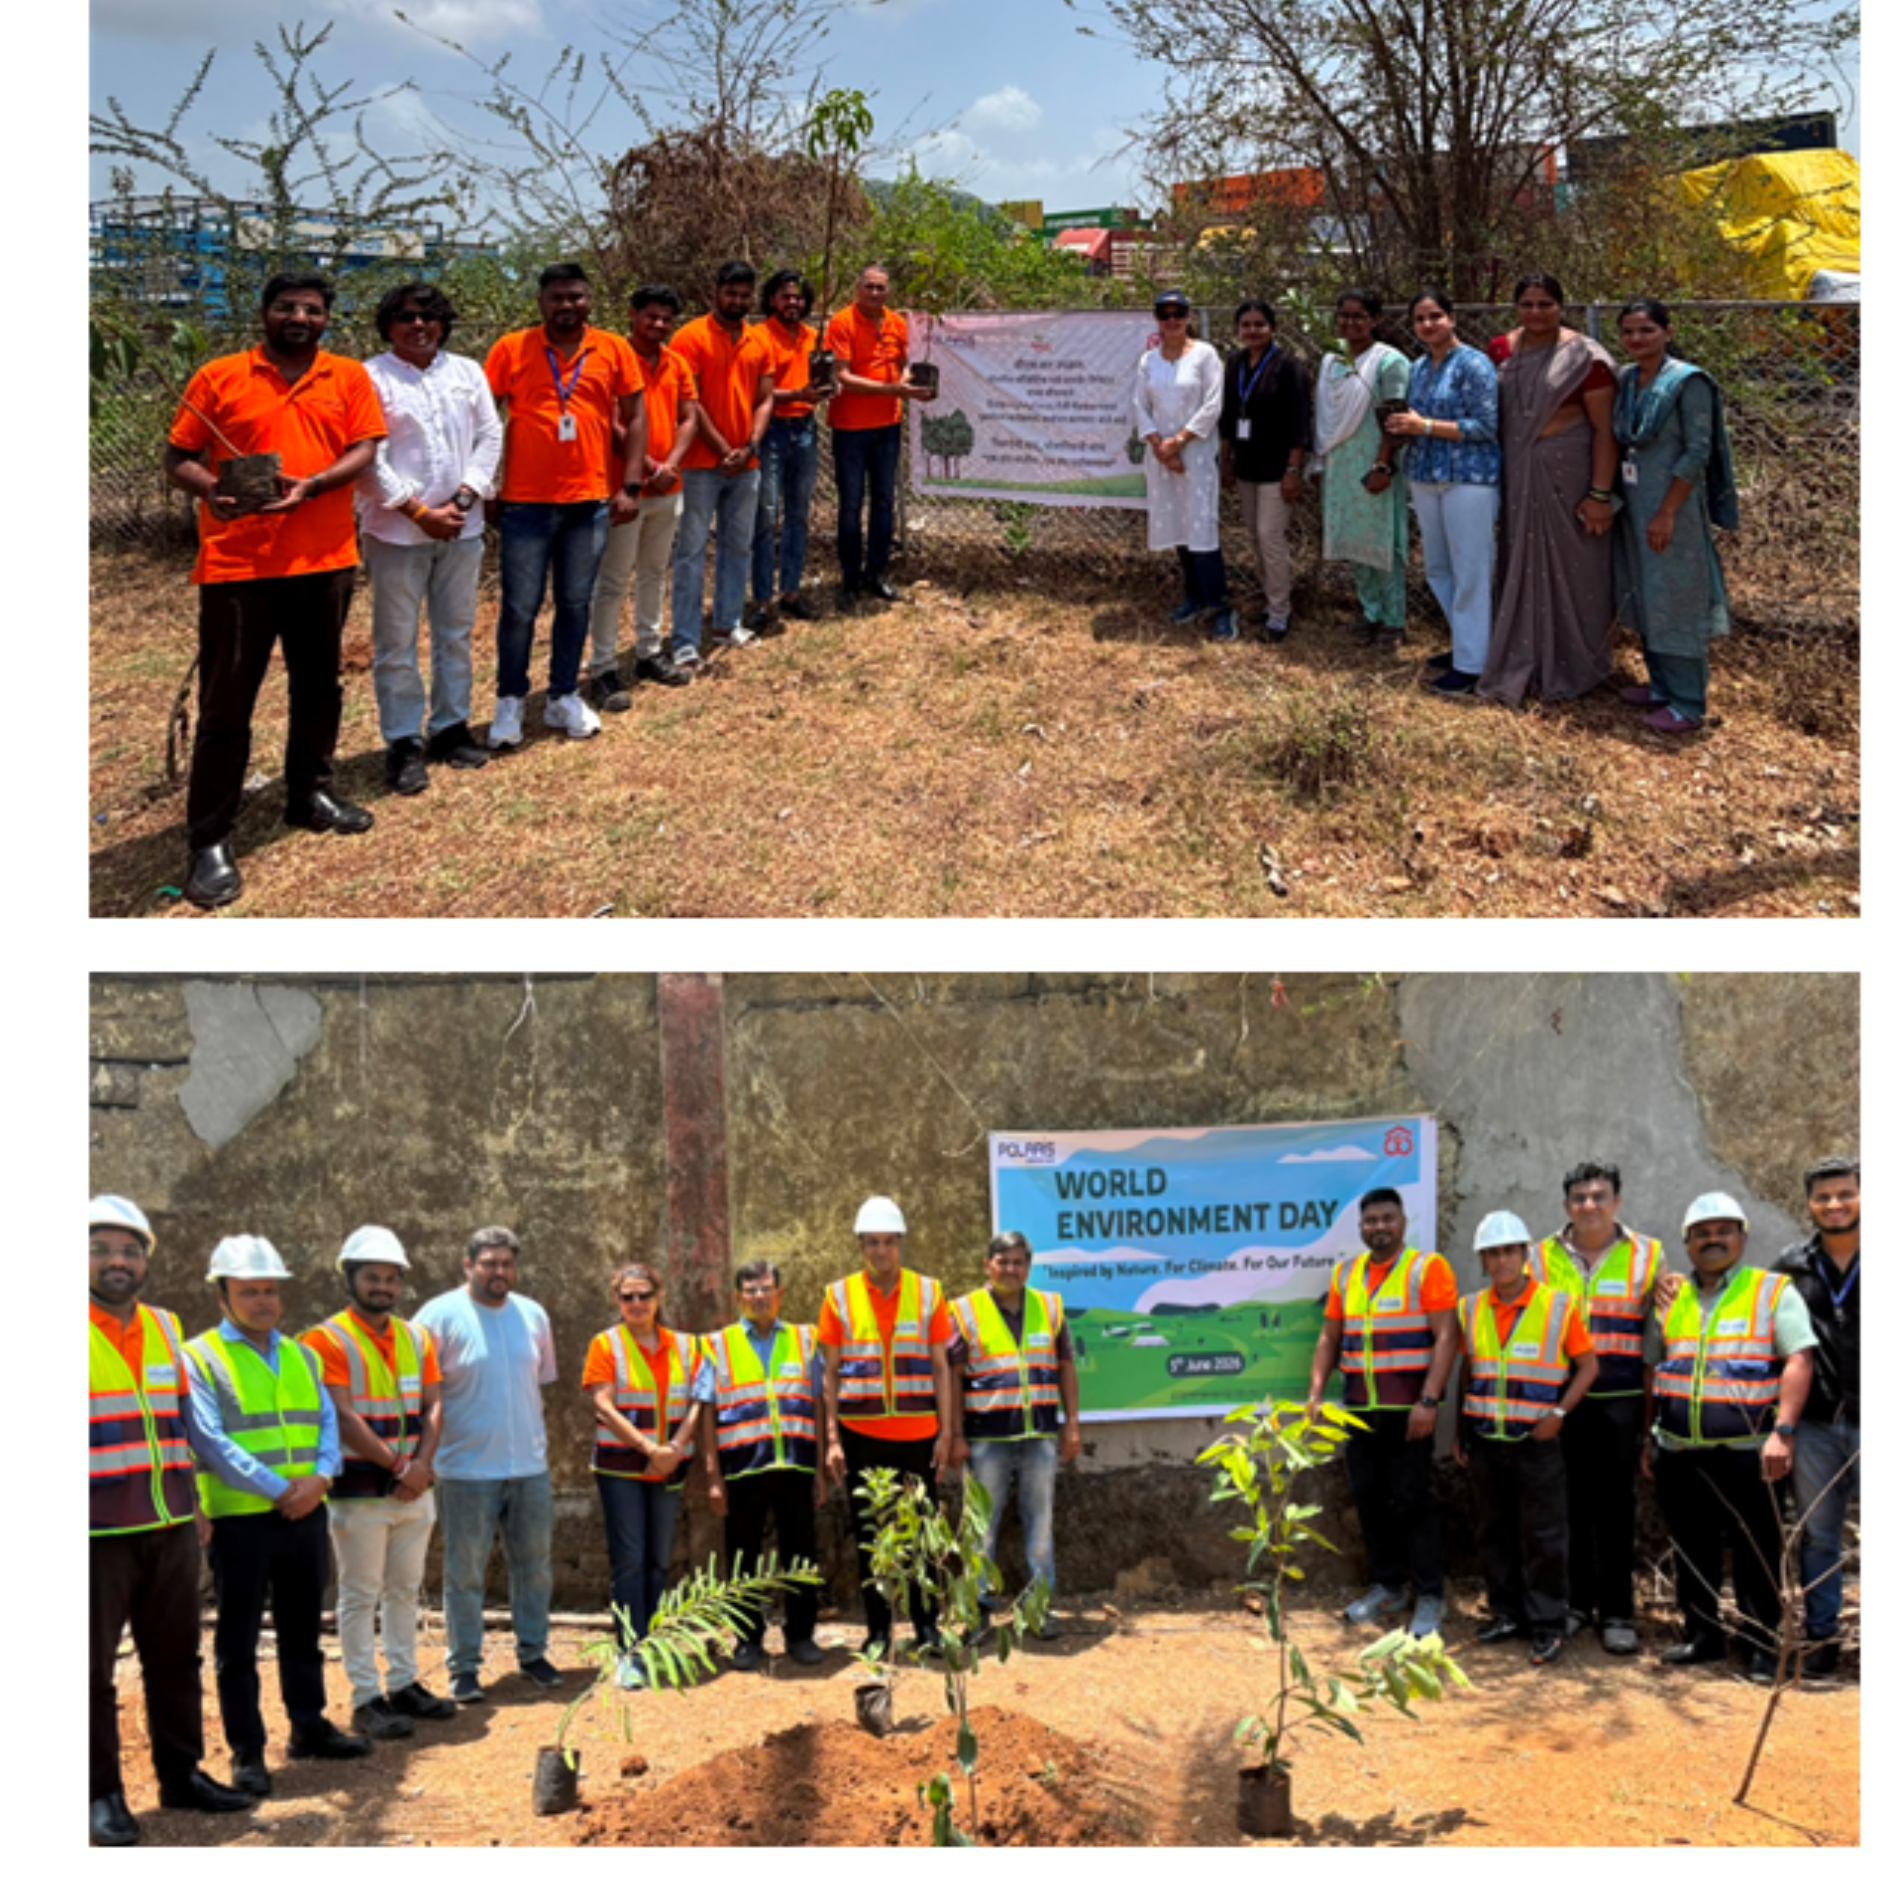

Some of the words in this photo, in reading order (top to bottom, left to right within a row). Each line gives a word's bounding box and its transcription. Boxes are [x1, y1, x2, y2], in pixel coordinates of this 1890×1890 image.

[1054, 1167, 1168, 1199] WORLD
[1057, 1203, 1271, 1240] ENVIRONMENT
[1279, 1199, 1339, 1230] DAY
[1099, 1264, 1113, 1281] by
[1116, 1262, 1162, 1276] Nature.
[1164, 1260, 1186, 1274] For
[1188, 1257, 1240, 1274] Climate.
[1243, 1256, 1264, 1271] For
[1266, 1255, 1289, 1270] Our
[1186, 1358, 1211, 1372] June
